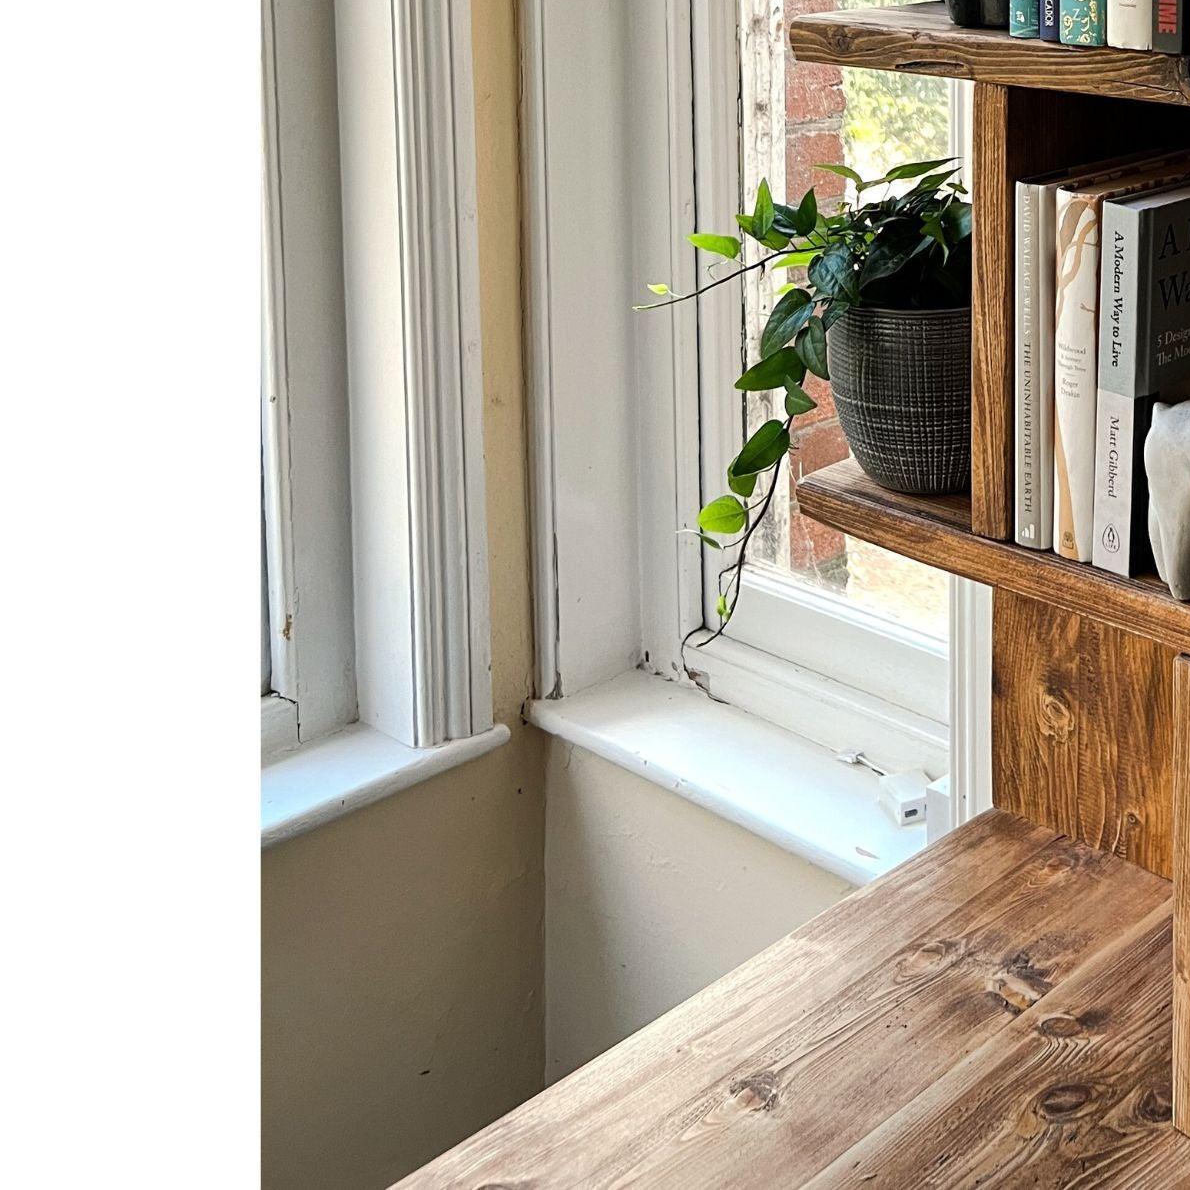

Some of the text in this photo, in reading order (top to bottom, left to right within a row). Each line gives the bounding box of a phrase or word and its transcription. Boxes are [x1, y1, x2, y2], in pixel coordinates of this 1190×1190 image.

[1024, 195, 1032, 232] DAVID
[1158, 223, 1181, 260] A
[1111, 230, 1125, 367] A Modern Way to Live
[1023, 343, 1031, 369] THE
[1157, 335, 1162, 347] 5
[1157, 351, 1172, 366] The
[1023, 371, 1033, 469] UNINHABITABLE
[1108, 415, 1120, 498] Matt Gibberd
[1024, 471, 1032, 513] EARTH
